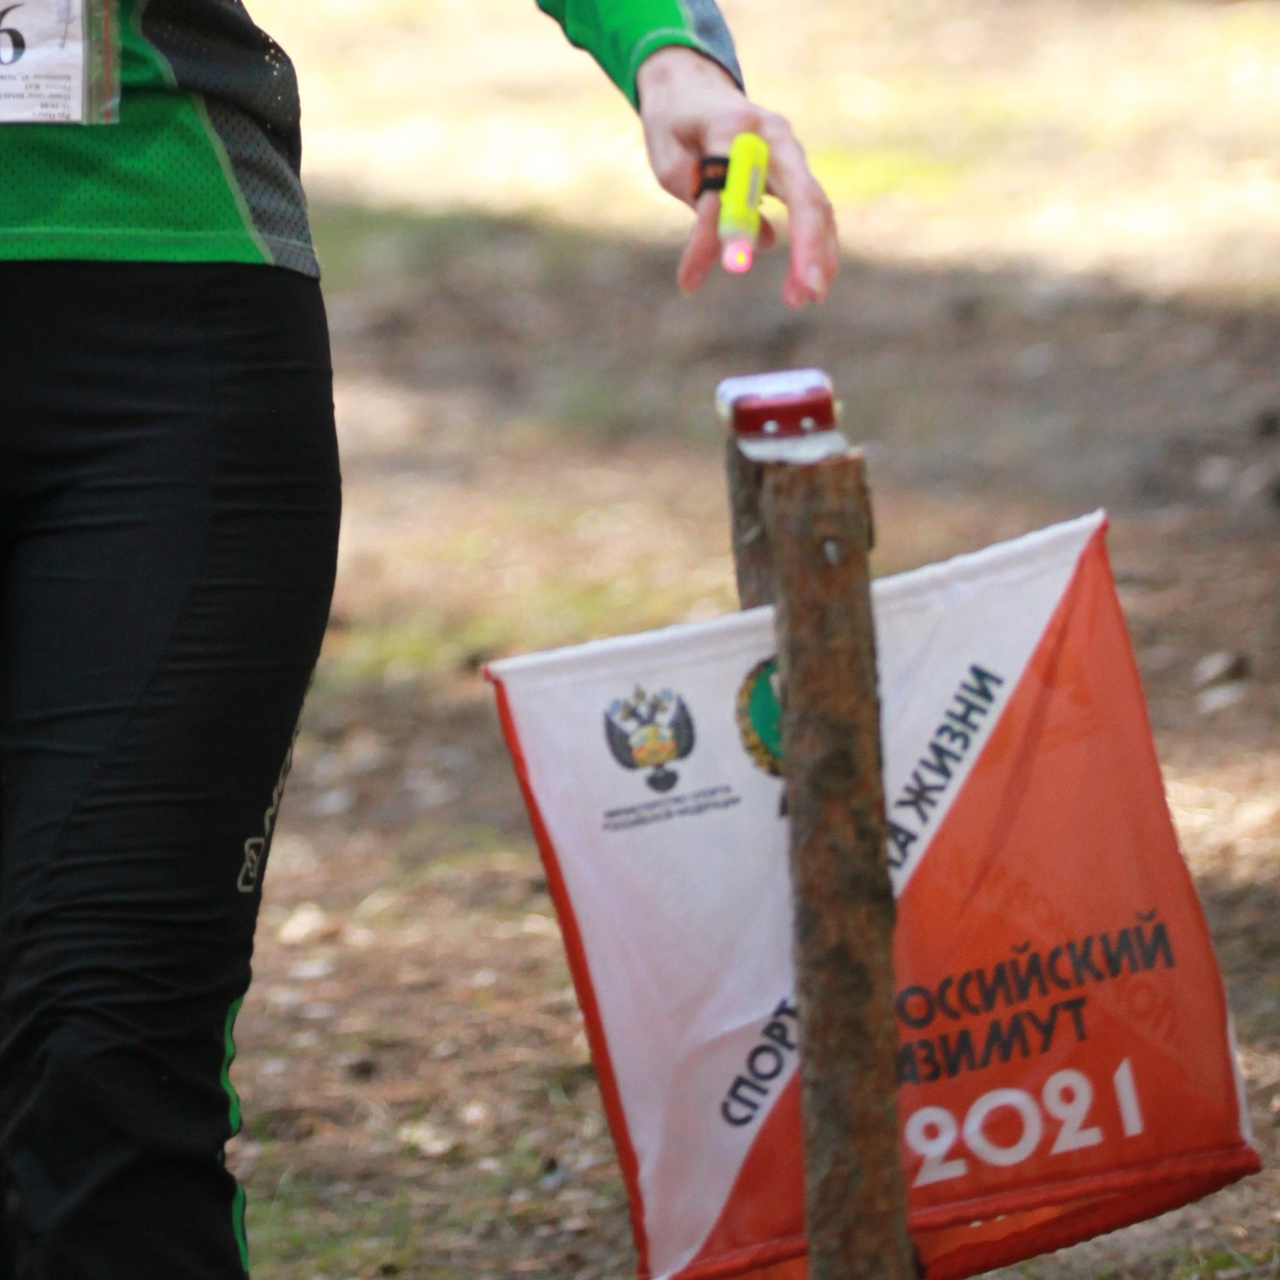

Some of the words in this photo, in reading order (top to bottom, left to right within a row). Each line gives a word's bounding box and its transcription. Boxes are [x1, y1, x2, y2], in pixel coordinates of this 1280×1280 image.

[720, 998, 799, 1127] СПОРТ
[894, 663, 1005, 825] ЖИЗНИ
[895, 908, 1176, 1030] ОССИЙСКИЙ
[895, 995, 1087, 1087] АЗИМУТ
[904, 1055, 1144, 1189] 2021
